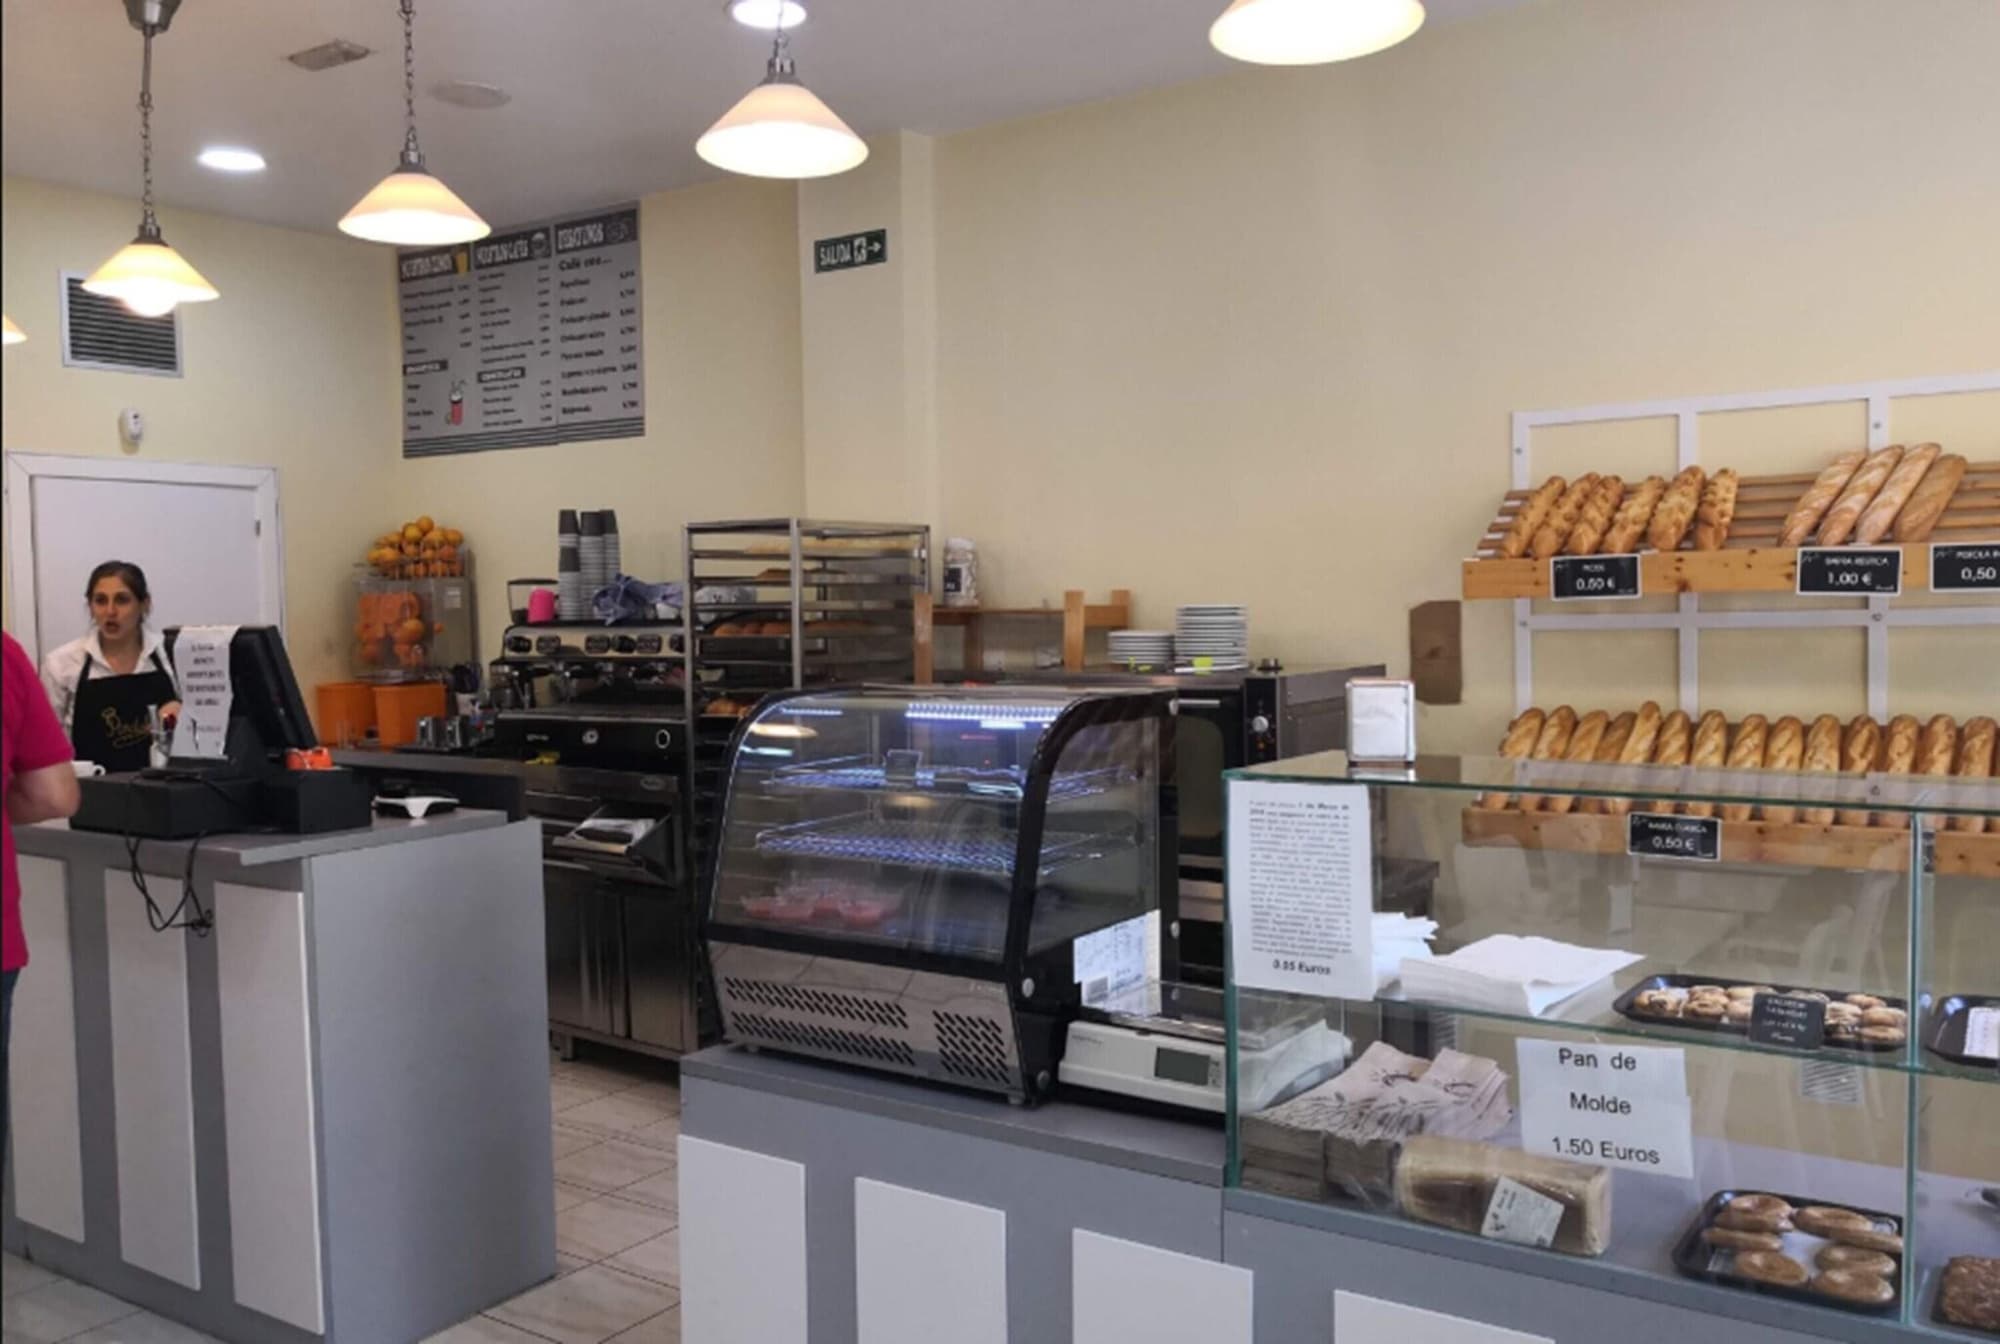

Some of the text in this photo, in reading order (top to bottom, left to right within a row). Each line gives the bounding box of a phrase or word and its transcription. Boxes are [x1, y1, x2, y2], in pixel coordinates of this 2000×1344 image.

[820, 242, 851, 266] SALIDA
[1828, 571, 1859, 586] 1,00
[1961, 566, 1997, 582] 0,50
[1298, 961, 1331, 975] Euros
[1558, 1048, 1636, 1071] Pan de
[1570, 1092, 1632, 1115] Molde
[1552, 1136, 1661, 1164] 1.50 Euros
